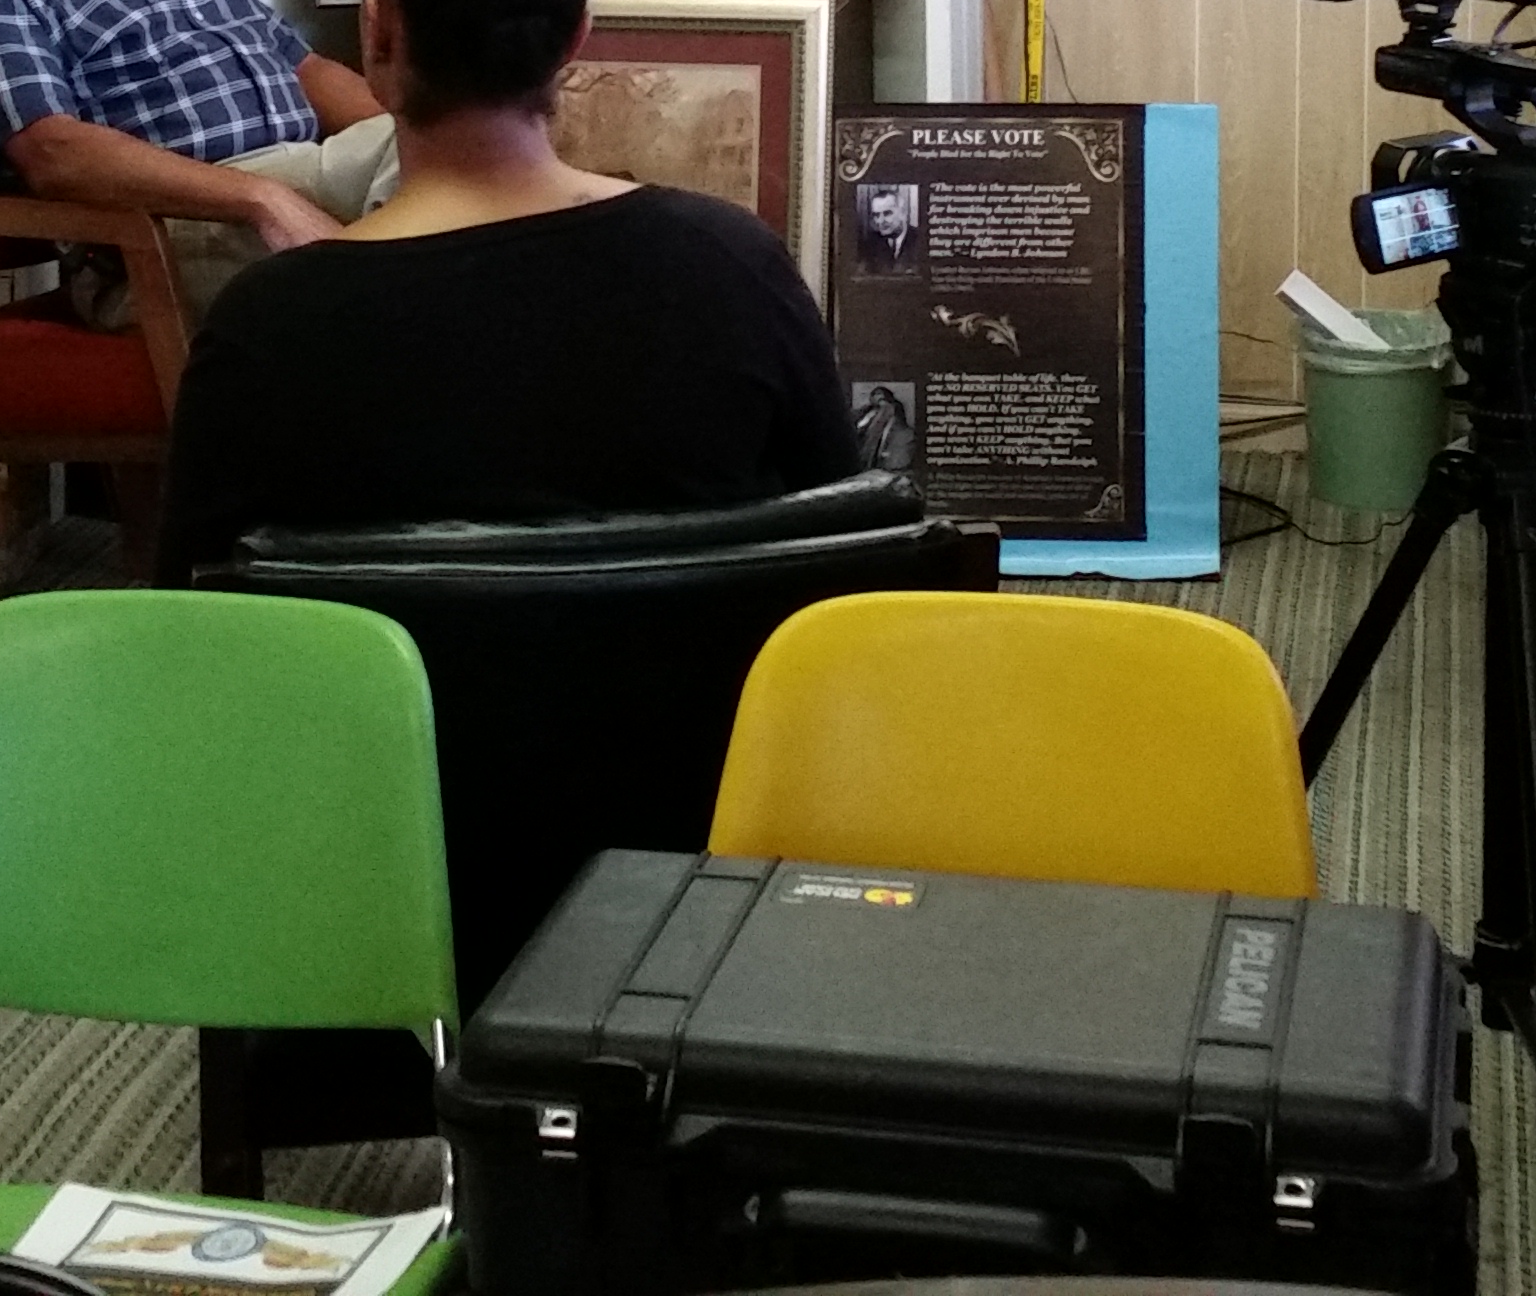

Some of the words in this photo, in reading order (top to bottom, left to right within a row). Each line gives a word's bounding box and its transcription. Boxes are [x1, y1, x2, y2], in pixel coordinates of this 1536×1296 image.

[912, 128, 987, 146] PLEASE
[990, 128, 1046, 146] VOTE
[1219, 929, 1275, 1029] PELICAN
